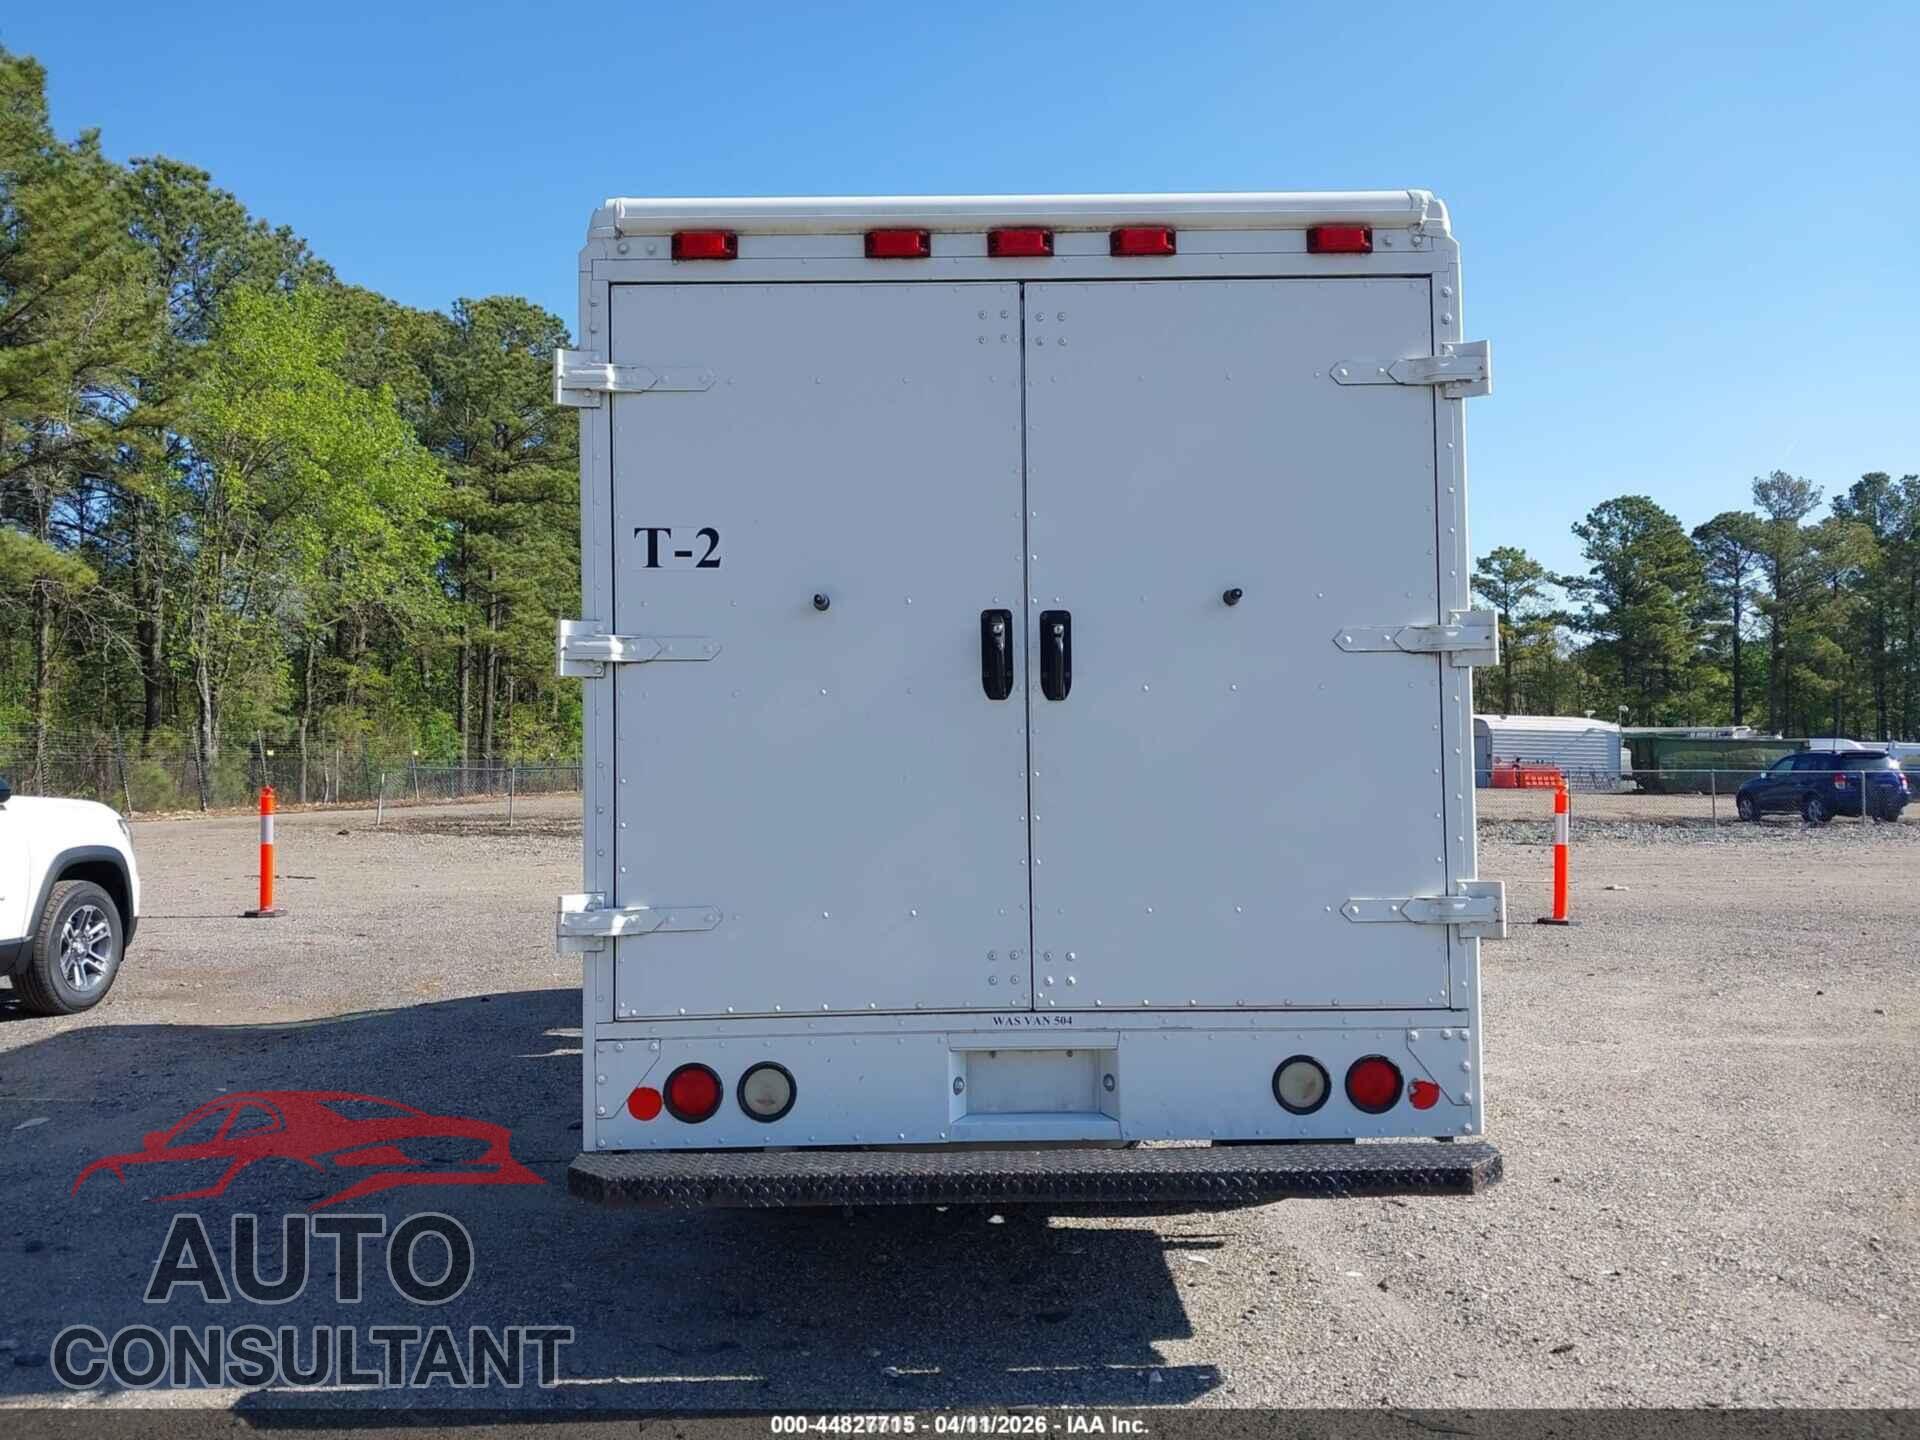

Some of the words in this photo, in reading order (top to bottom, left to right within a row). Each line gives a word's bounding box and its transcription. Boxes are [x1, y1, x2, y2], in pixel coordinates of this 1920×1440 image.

[634, 527, 721, 568] T-2
[992, 1016, 1021, 1025] WAS
[1024, 1016, 1051, 1025] VAN
[1054, 1015, 1073, 1025] 504
